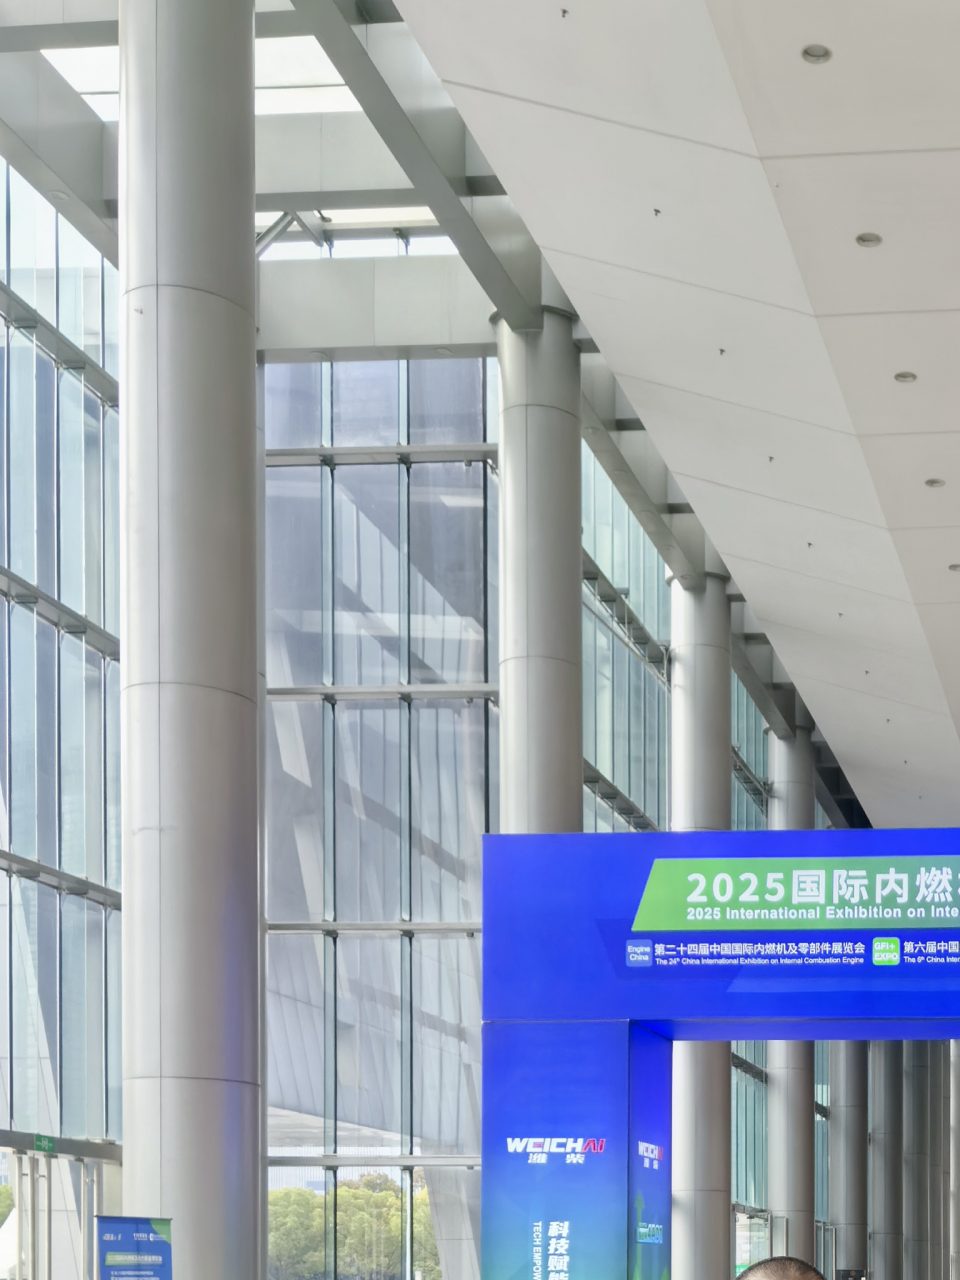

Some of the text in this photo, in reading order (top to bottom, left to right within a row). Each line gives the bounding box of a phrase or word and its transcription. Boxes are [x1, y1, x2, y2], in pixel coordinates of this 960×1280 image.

[687, 907, 721, 920] 2025
[726, 906, 820, 919] International
[826, 905, 902, 919] Exhibition
[907, 907, 926, 918] on
[627, 945, 651, 954] Engine
[654, 941, 866, 956] 第二十四届中国国际内燃机及零部件展览会
[629, 953, 649, 961] China
[655, 957, 668, 966] The
[681, 957, 700, 965] China
[701, 957, 739, 965] International
[740, 957, 769, 965] Exhibition
[804, 956, 842, 964] Combustion
[842, 956, 865, 965] Engine
[904, 955, 916, 963] The
[926, 955, 945, 963] China
[506, 1137, 606, 1153] WEICHAI
[532, 1221, 542, 1245] TECH
